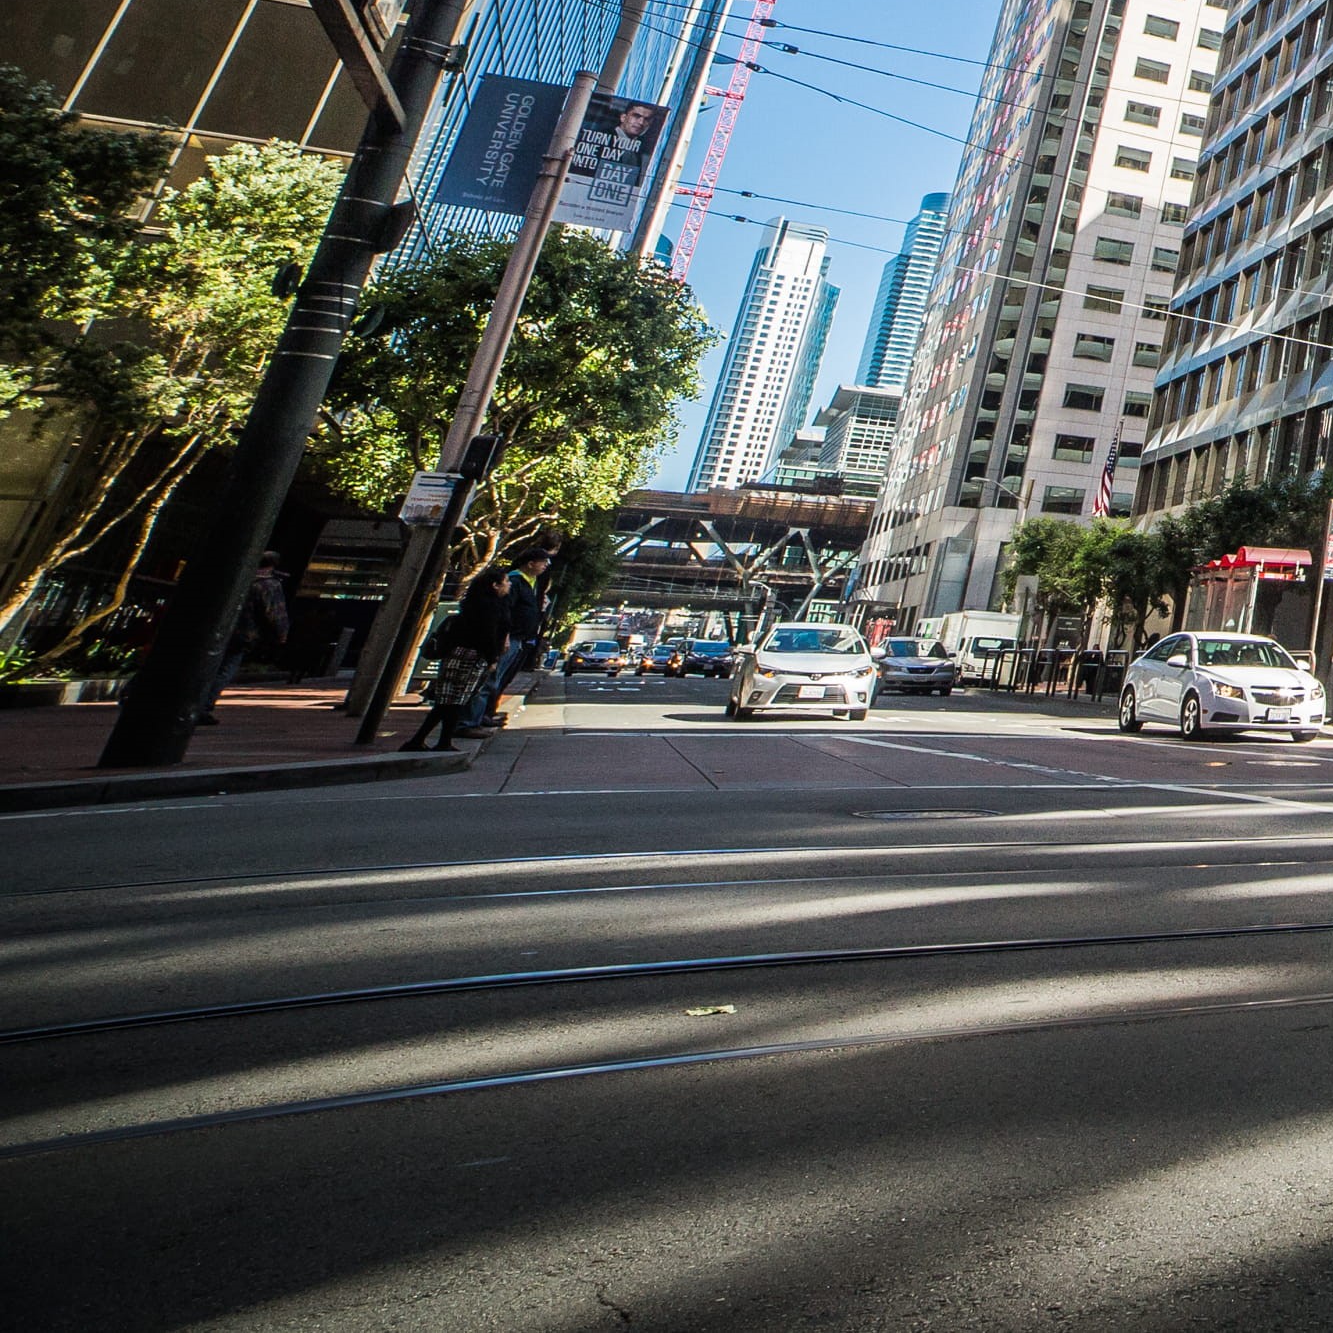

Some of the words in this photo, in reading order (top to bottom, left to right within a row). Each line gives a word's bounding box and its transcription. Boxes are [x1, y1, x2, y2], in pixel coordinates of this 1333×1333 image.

[505, 95, 535, 150] GOLDEN
[476, 93, 520, 186] UNIVERSITY
[581, 128, 612, 147] TURN
[613, 134, 642, 153] YOUR
[573, 153, 598, 170] INTO
[576, 141, 600, 158] ONE
[601, 148, 625, 162] DAY
[491, 152, 515, 188] GATE
[600, 163, 633, 183] DAY
[594, 181, 628, 202] ONE
